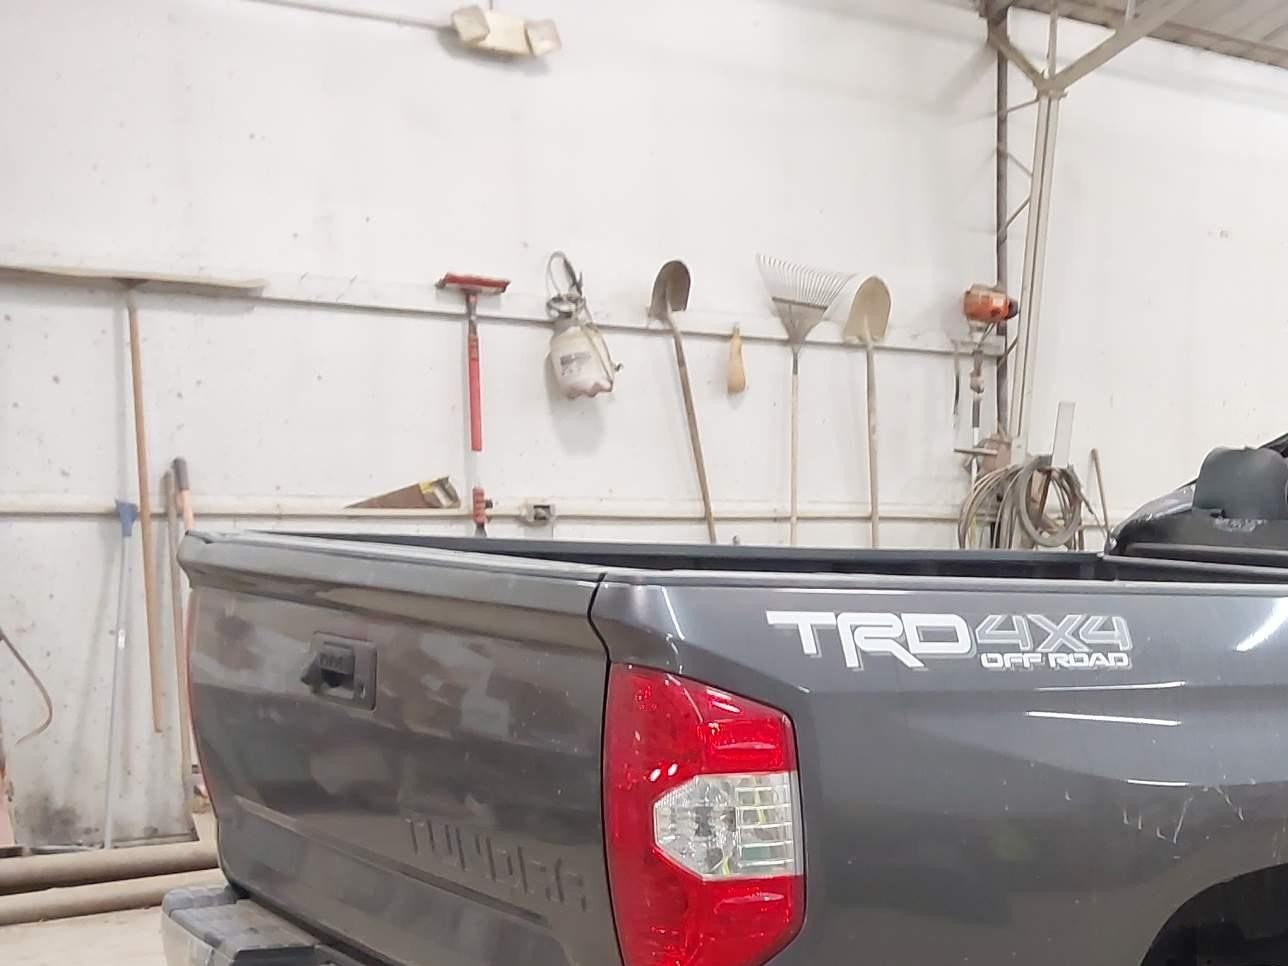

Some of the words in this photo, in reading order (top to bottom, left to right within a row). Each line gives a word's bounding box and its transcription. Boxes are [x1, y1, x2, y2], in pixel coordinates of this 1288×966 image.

[765, 610, 974, 670] TRD
[974, 613, 1132, 651] 4X4
[980, 651, 1045, 669] OFF
[1048, 651, 1132, 669] ROAD
